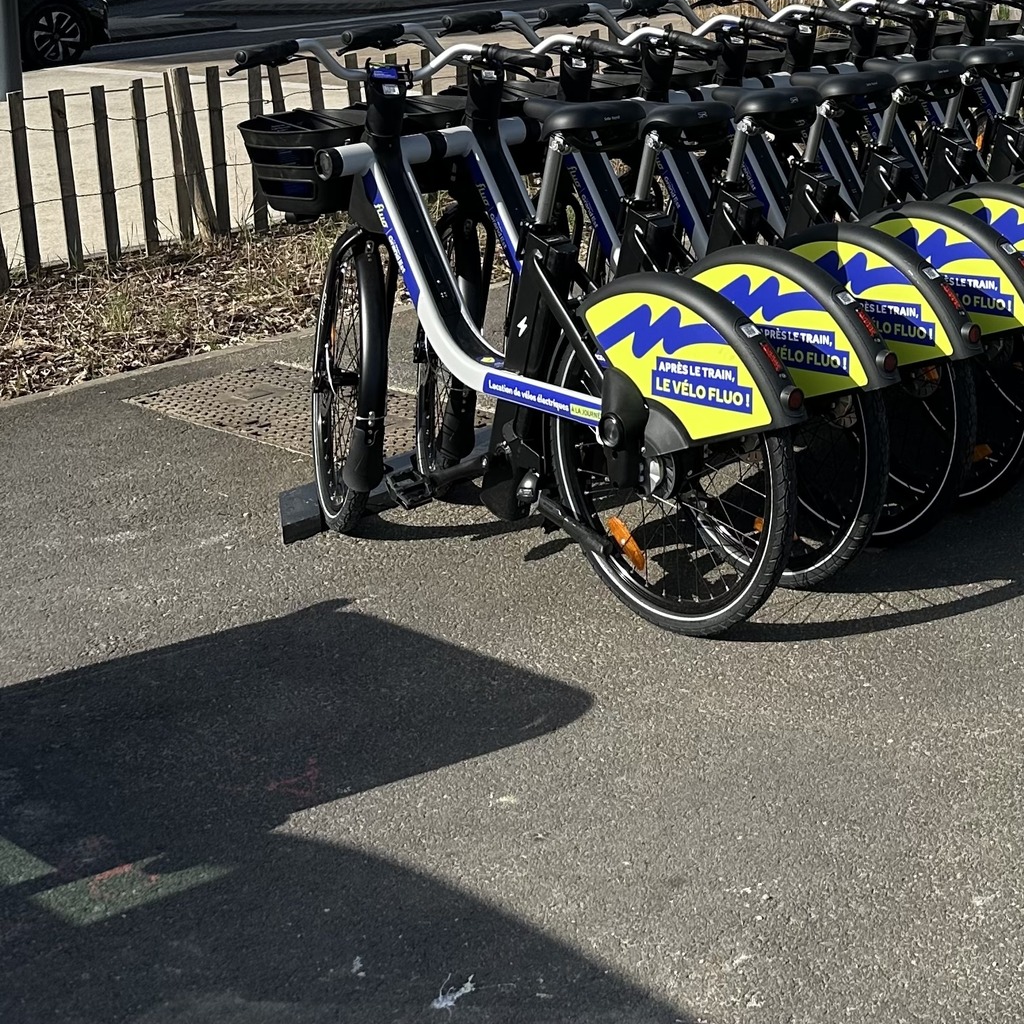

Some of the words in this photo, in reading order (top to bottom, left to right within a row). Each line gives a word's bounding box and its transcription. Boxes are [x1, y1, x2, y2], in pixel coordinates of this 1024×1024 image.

[973, 86, 986, 105] fluo
[920, 99, 932, 116] fluo
[567, 166, 581, 188] fluo
[476, 183, 490, 206] fluo
[373, 203, 389, 228] fluo
[956, 278, 966, 287] LE
[967, 278, 998, 291] TRAIN,
[876, 304, 887, 314] LE
[887, 305, 919, 319] TRAIN,
[973, 296, 1006, 310] FLUO
[1007, 299, 1012, 312] !
[787, 331, 799, 342] LE
[801, 332, 833, 347] TRAIN,
[893, 323, 927, 339] FLUO
[928, 328, 933, 340] !
[806, 352, 840, 369] FLUO
[841, 357, 847, 370] !
[658, 361, 689, 375] APRÈS
[689, 364, 700, 376] LE
[702, 367, 735, 382] TRAIN,
[488, 379, 513, 395] Location
[513, 387, 521, 396] de
[521, 390, 537, 402] vélos
[537, 394, 569, 412] électriques
[655, 377, 671, 392] LE
[673, 379, 707, 398] VÉLO
[708, 387, 744, 406] FLUO
[745, 393, 750, 408] !
